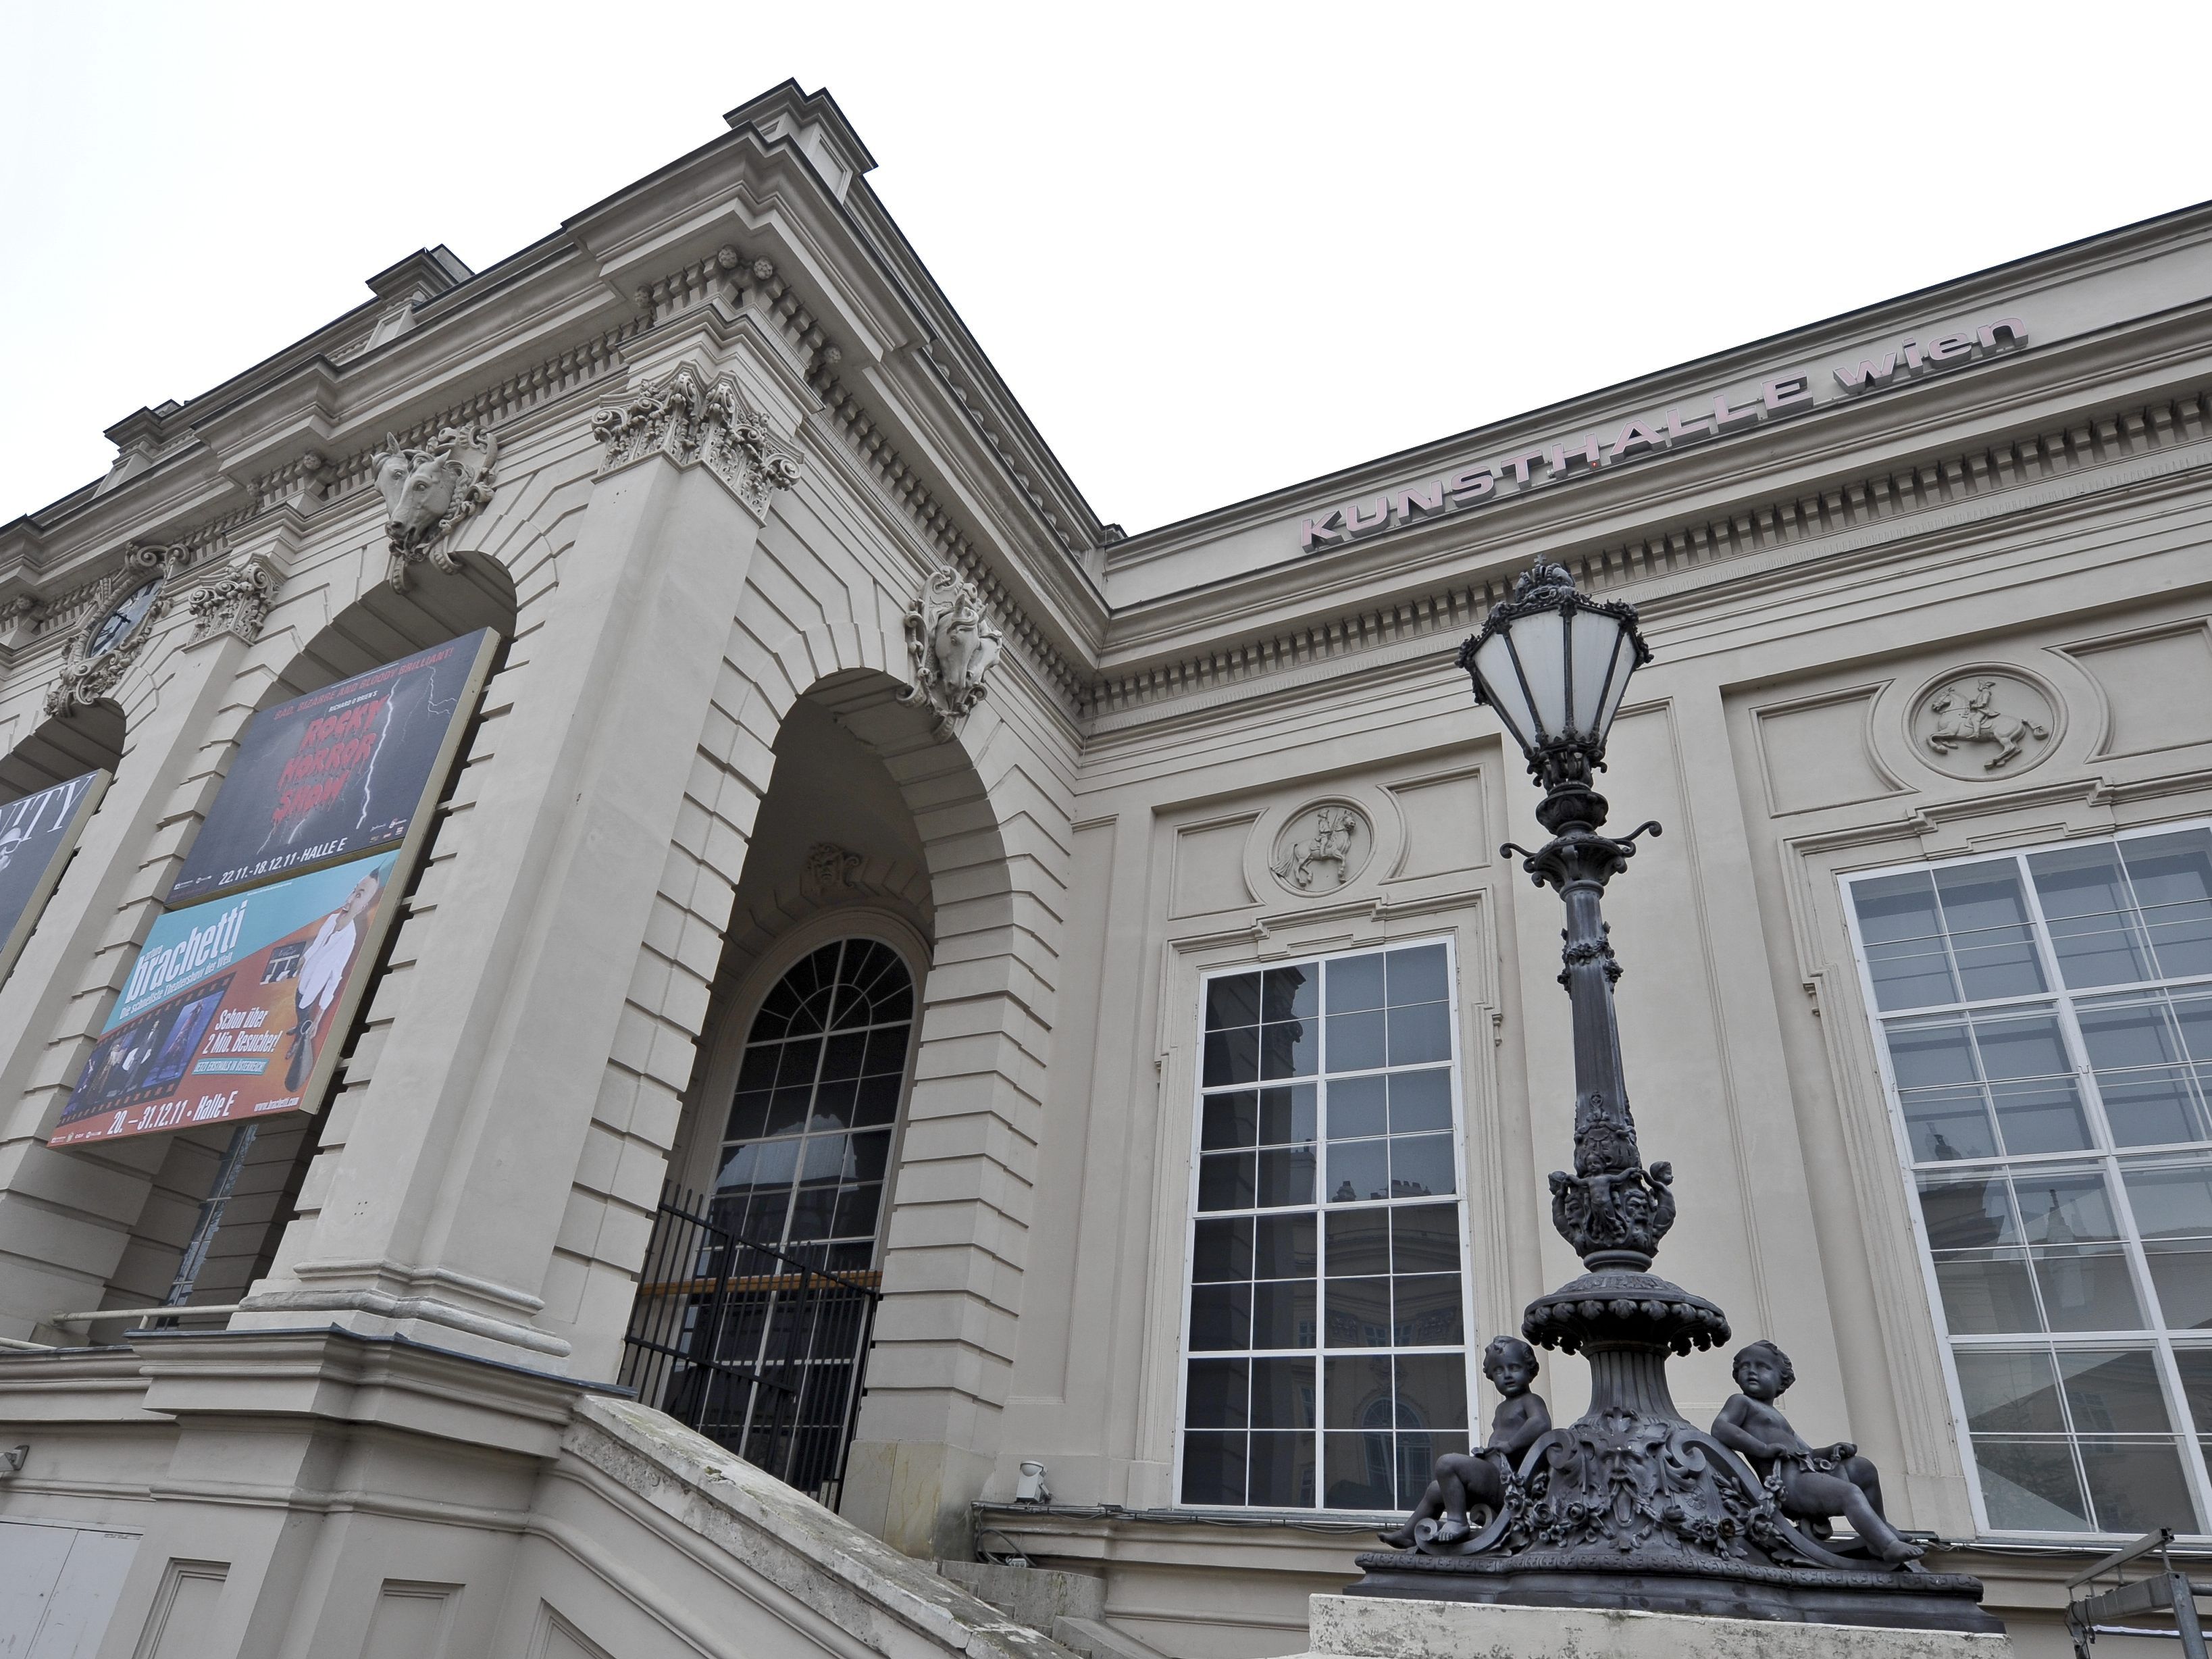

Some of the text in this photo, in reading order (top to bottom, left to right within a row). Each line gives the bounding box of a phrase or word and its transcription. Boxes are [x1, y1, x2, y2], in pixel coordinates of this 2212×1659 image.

[1301, 317, 2029, 553] KUNSTHALLE wien
[297, 692, 336, 711] BIZARRE
[337, 684, 358, 697] AND
[359, 669, 398, 688] BLOODY
[398, 648, 454, 675] BRILLIANT!
[328, 699, 351, 712] RICHARD
[299, 694, 390, 752] ROCKY
[278, 733, 377, 790] HORROR
[272, 770, 349, 823] SHOW
[300, 840, 338, 863] HALLE
[336, 837, 348, 851] E
[124, 899, 249, 1004] brachetti
[119, 952, 233, 1020] Die schnellste Theatershow der Welt
[202, 1030, 283, 1054] 2 Mio. Besucher!
[215, 1006, 269, 1030] Schon über
[107, 1110, 128, 1135] 20.
[192, 1093, 226, 1121] Halle
[222, 1090, 238, 1117] E
